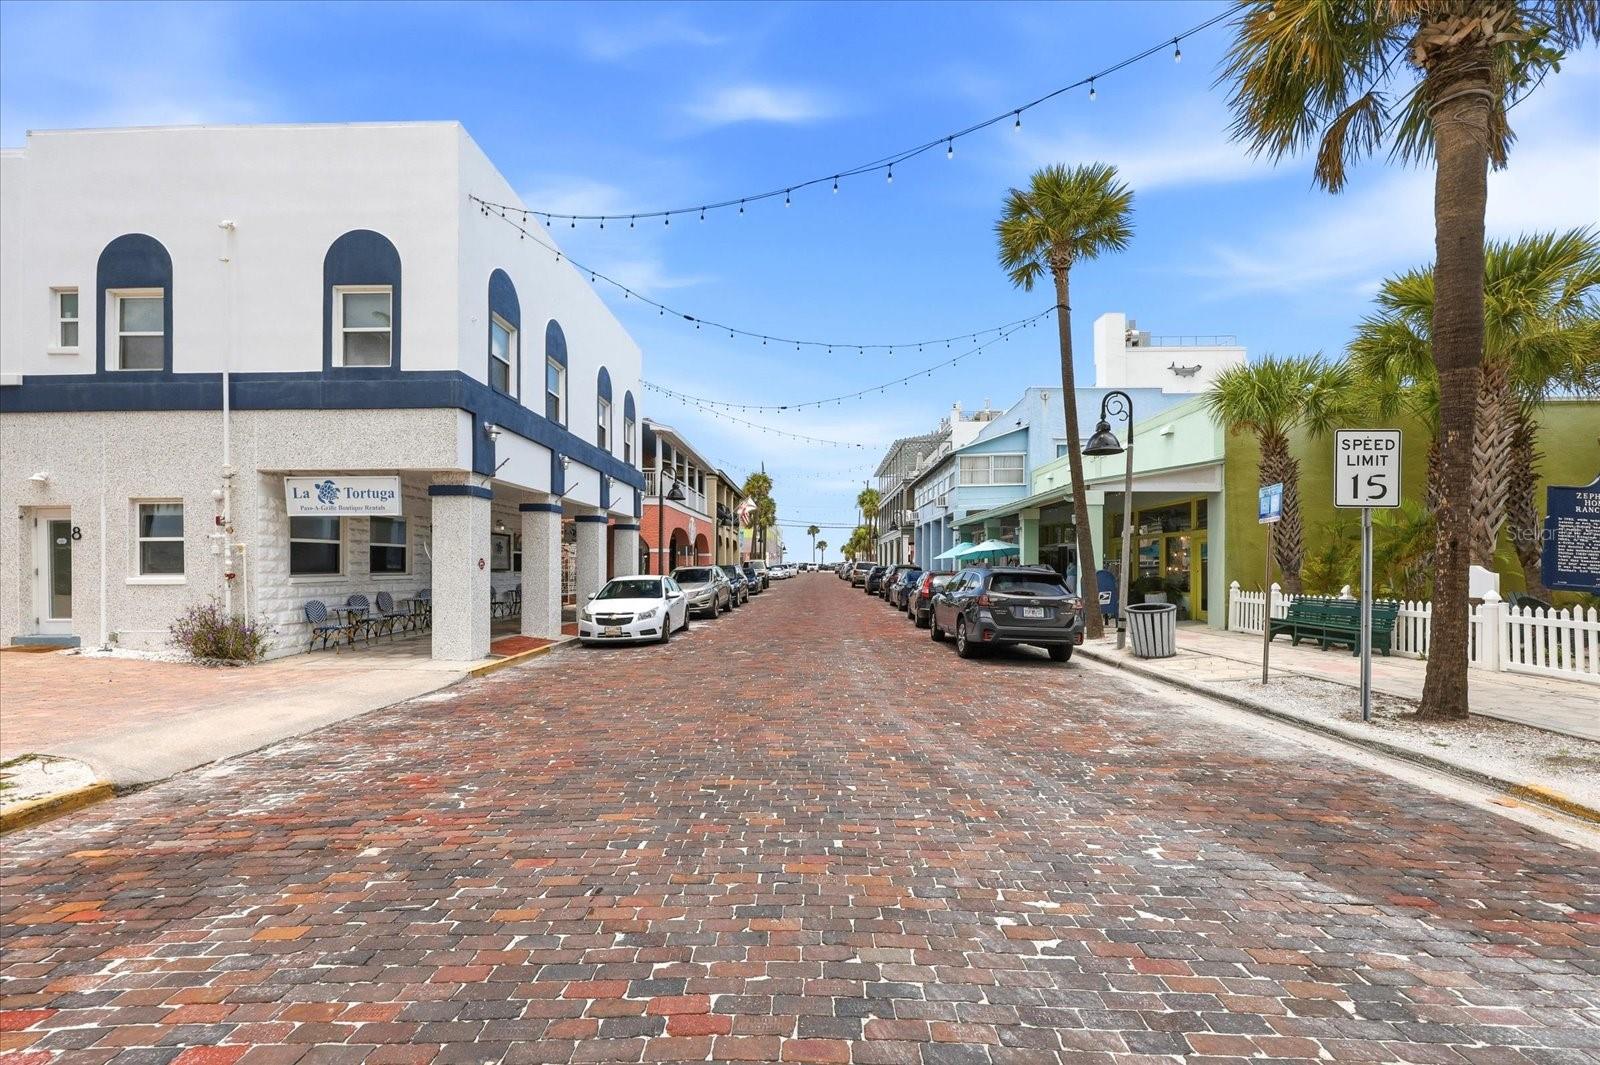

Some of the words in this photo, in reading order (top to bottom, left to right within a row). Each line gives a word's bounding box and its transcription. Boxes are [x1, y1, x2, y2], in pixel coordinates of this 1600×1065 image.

[1342, 439, 1395, 450] SPEED
[1347, 455, 1389, 466] LIMIT
[1351, 473, 1388, 500] 15
[293, 487, 310, 499] La
[343, 487, 395, 501] Tortuga
[71, 525, 82, 540] 8
